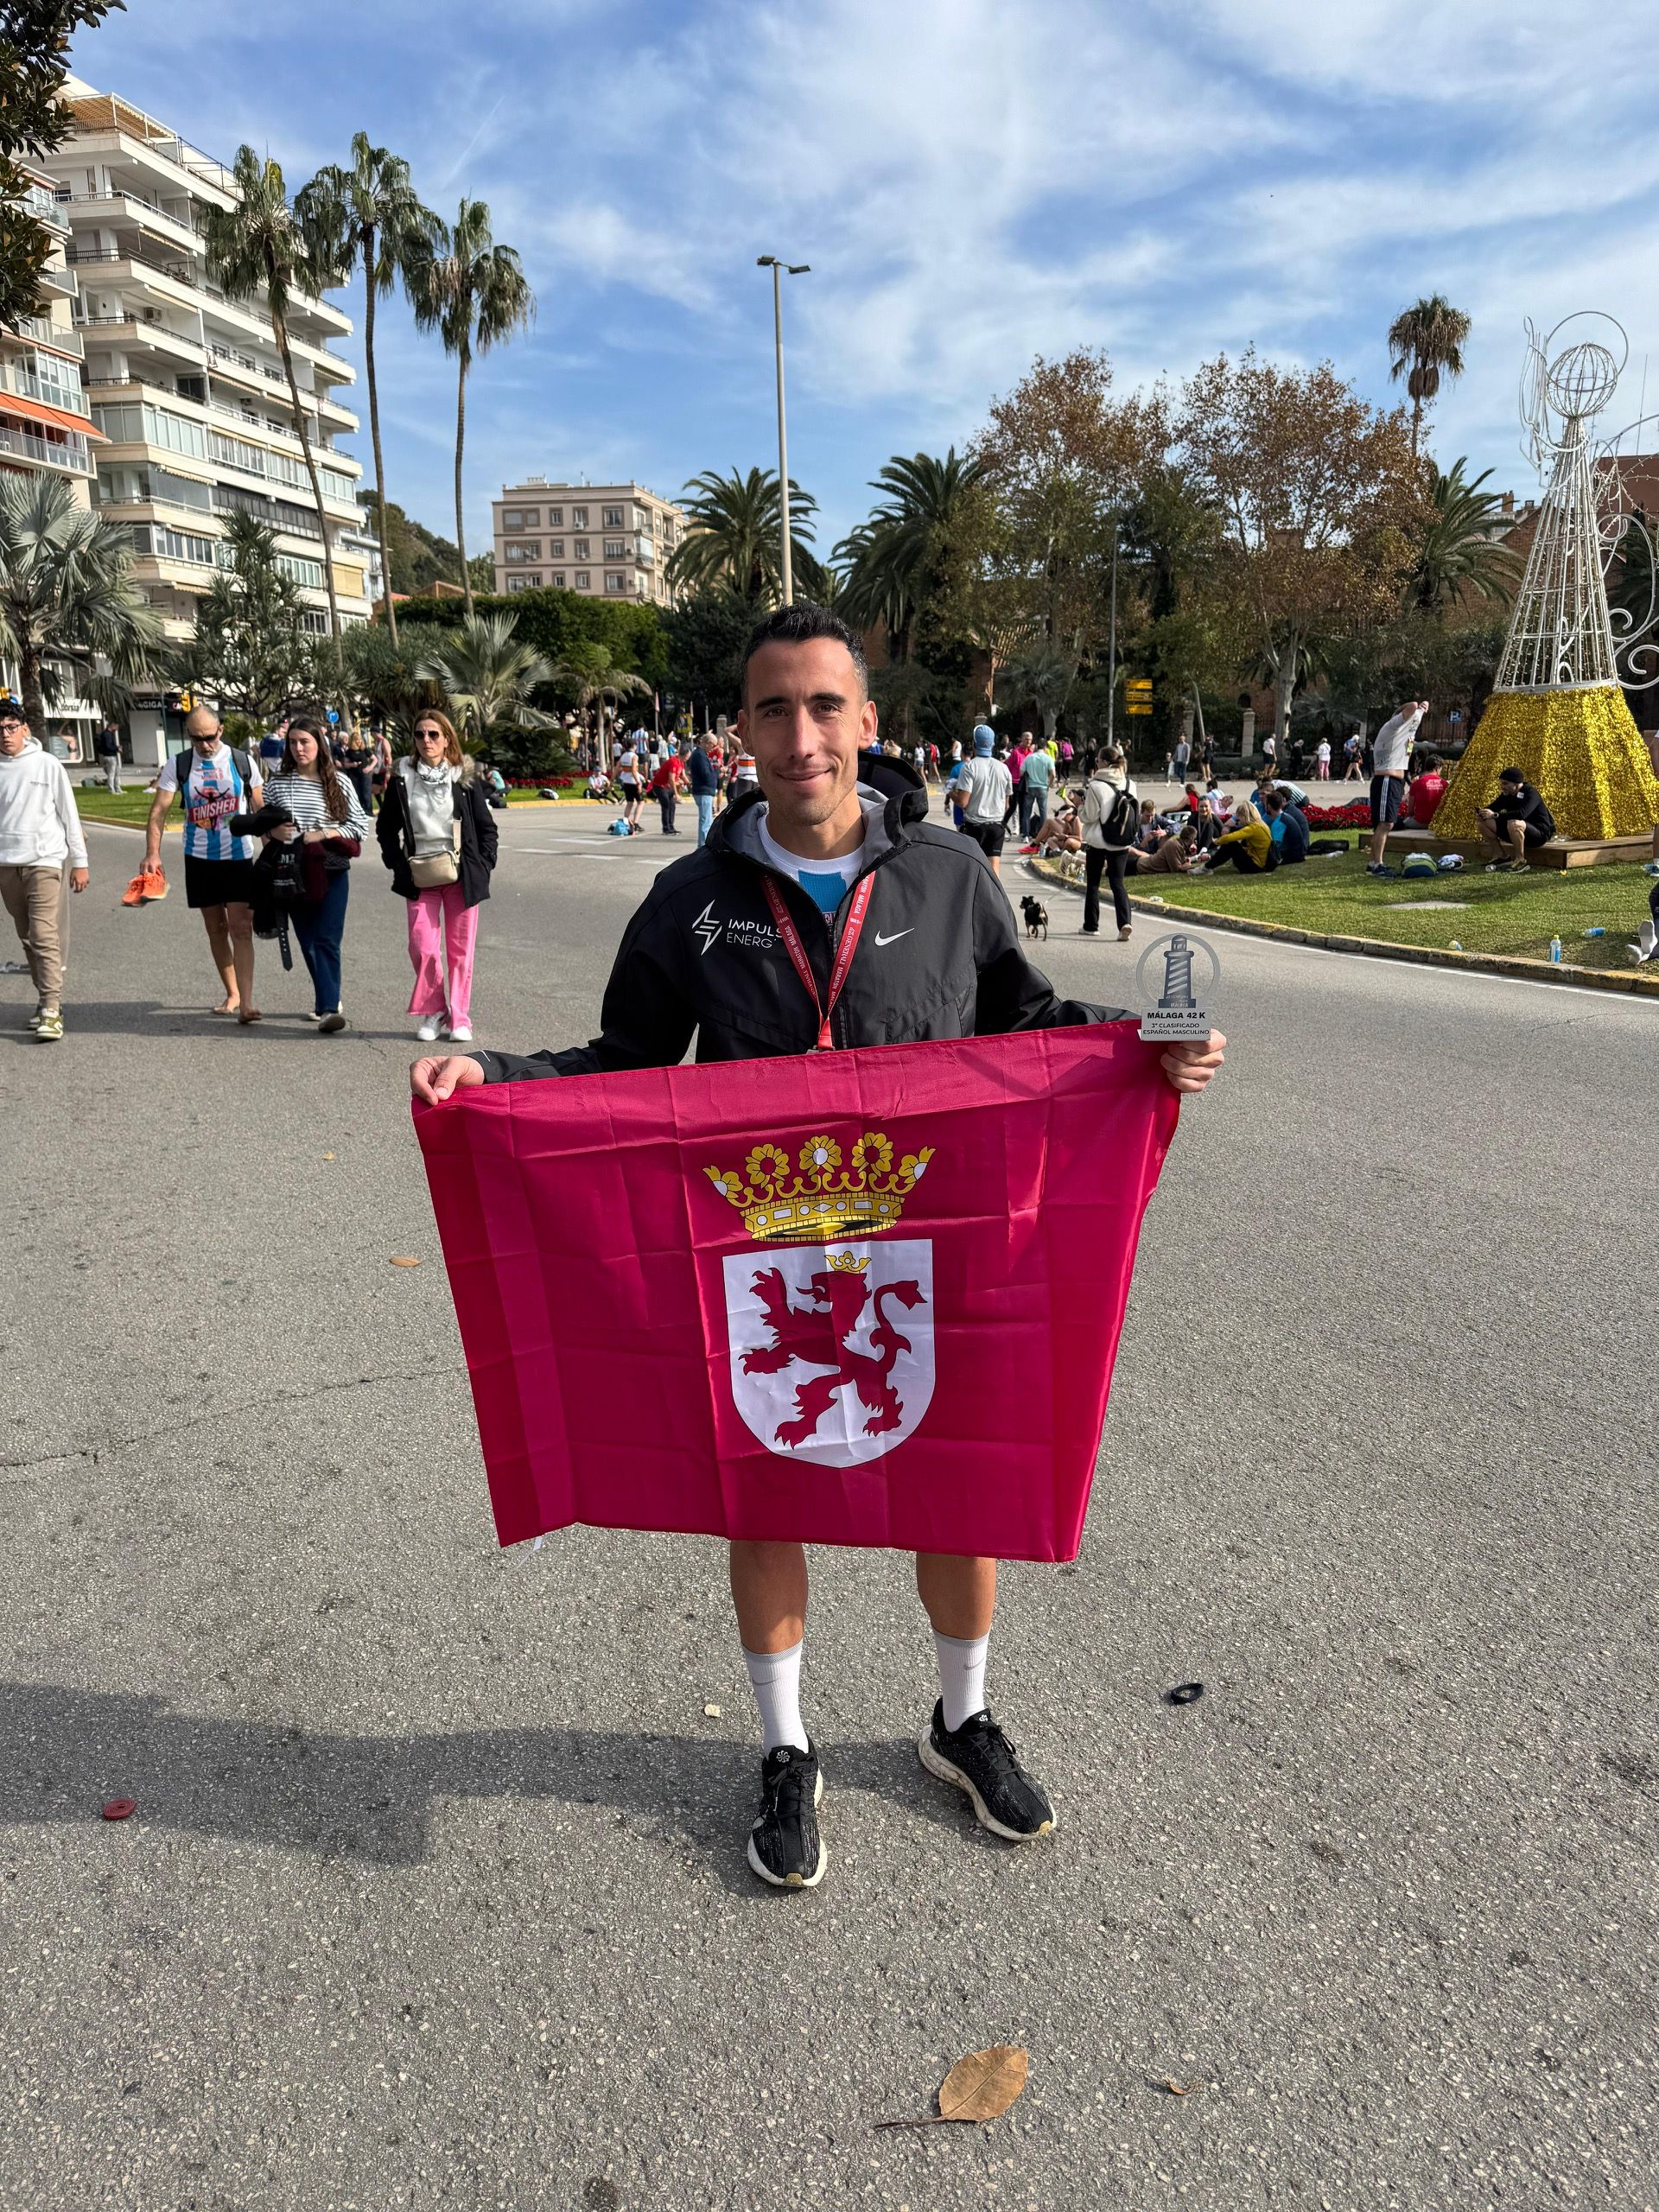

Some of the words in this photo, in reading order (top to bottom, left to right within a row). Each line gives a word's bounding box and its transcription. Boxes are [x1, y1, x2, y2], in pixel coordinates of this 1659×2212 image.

[193, 797, 237, 821] FINISHER
[726, 931, 777, 949] ENERG
[1147, 1010, 1184, 1019] MÁLAGA
